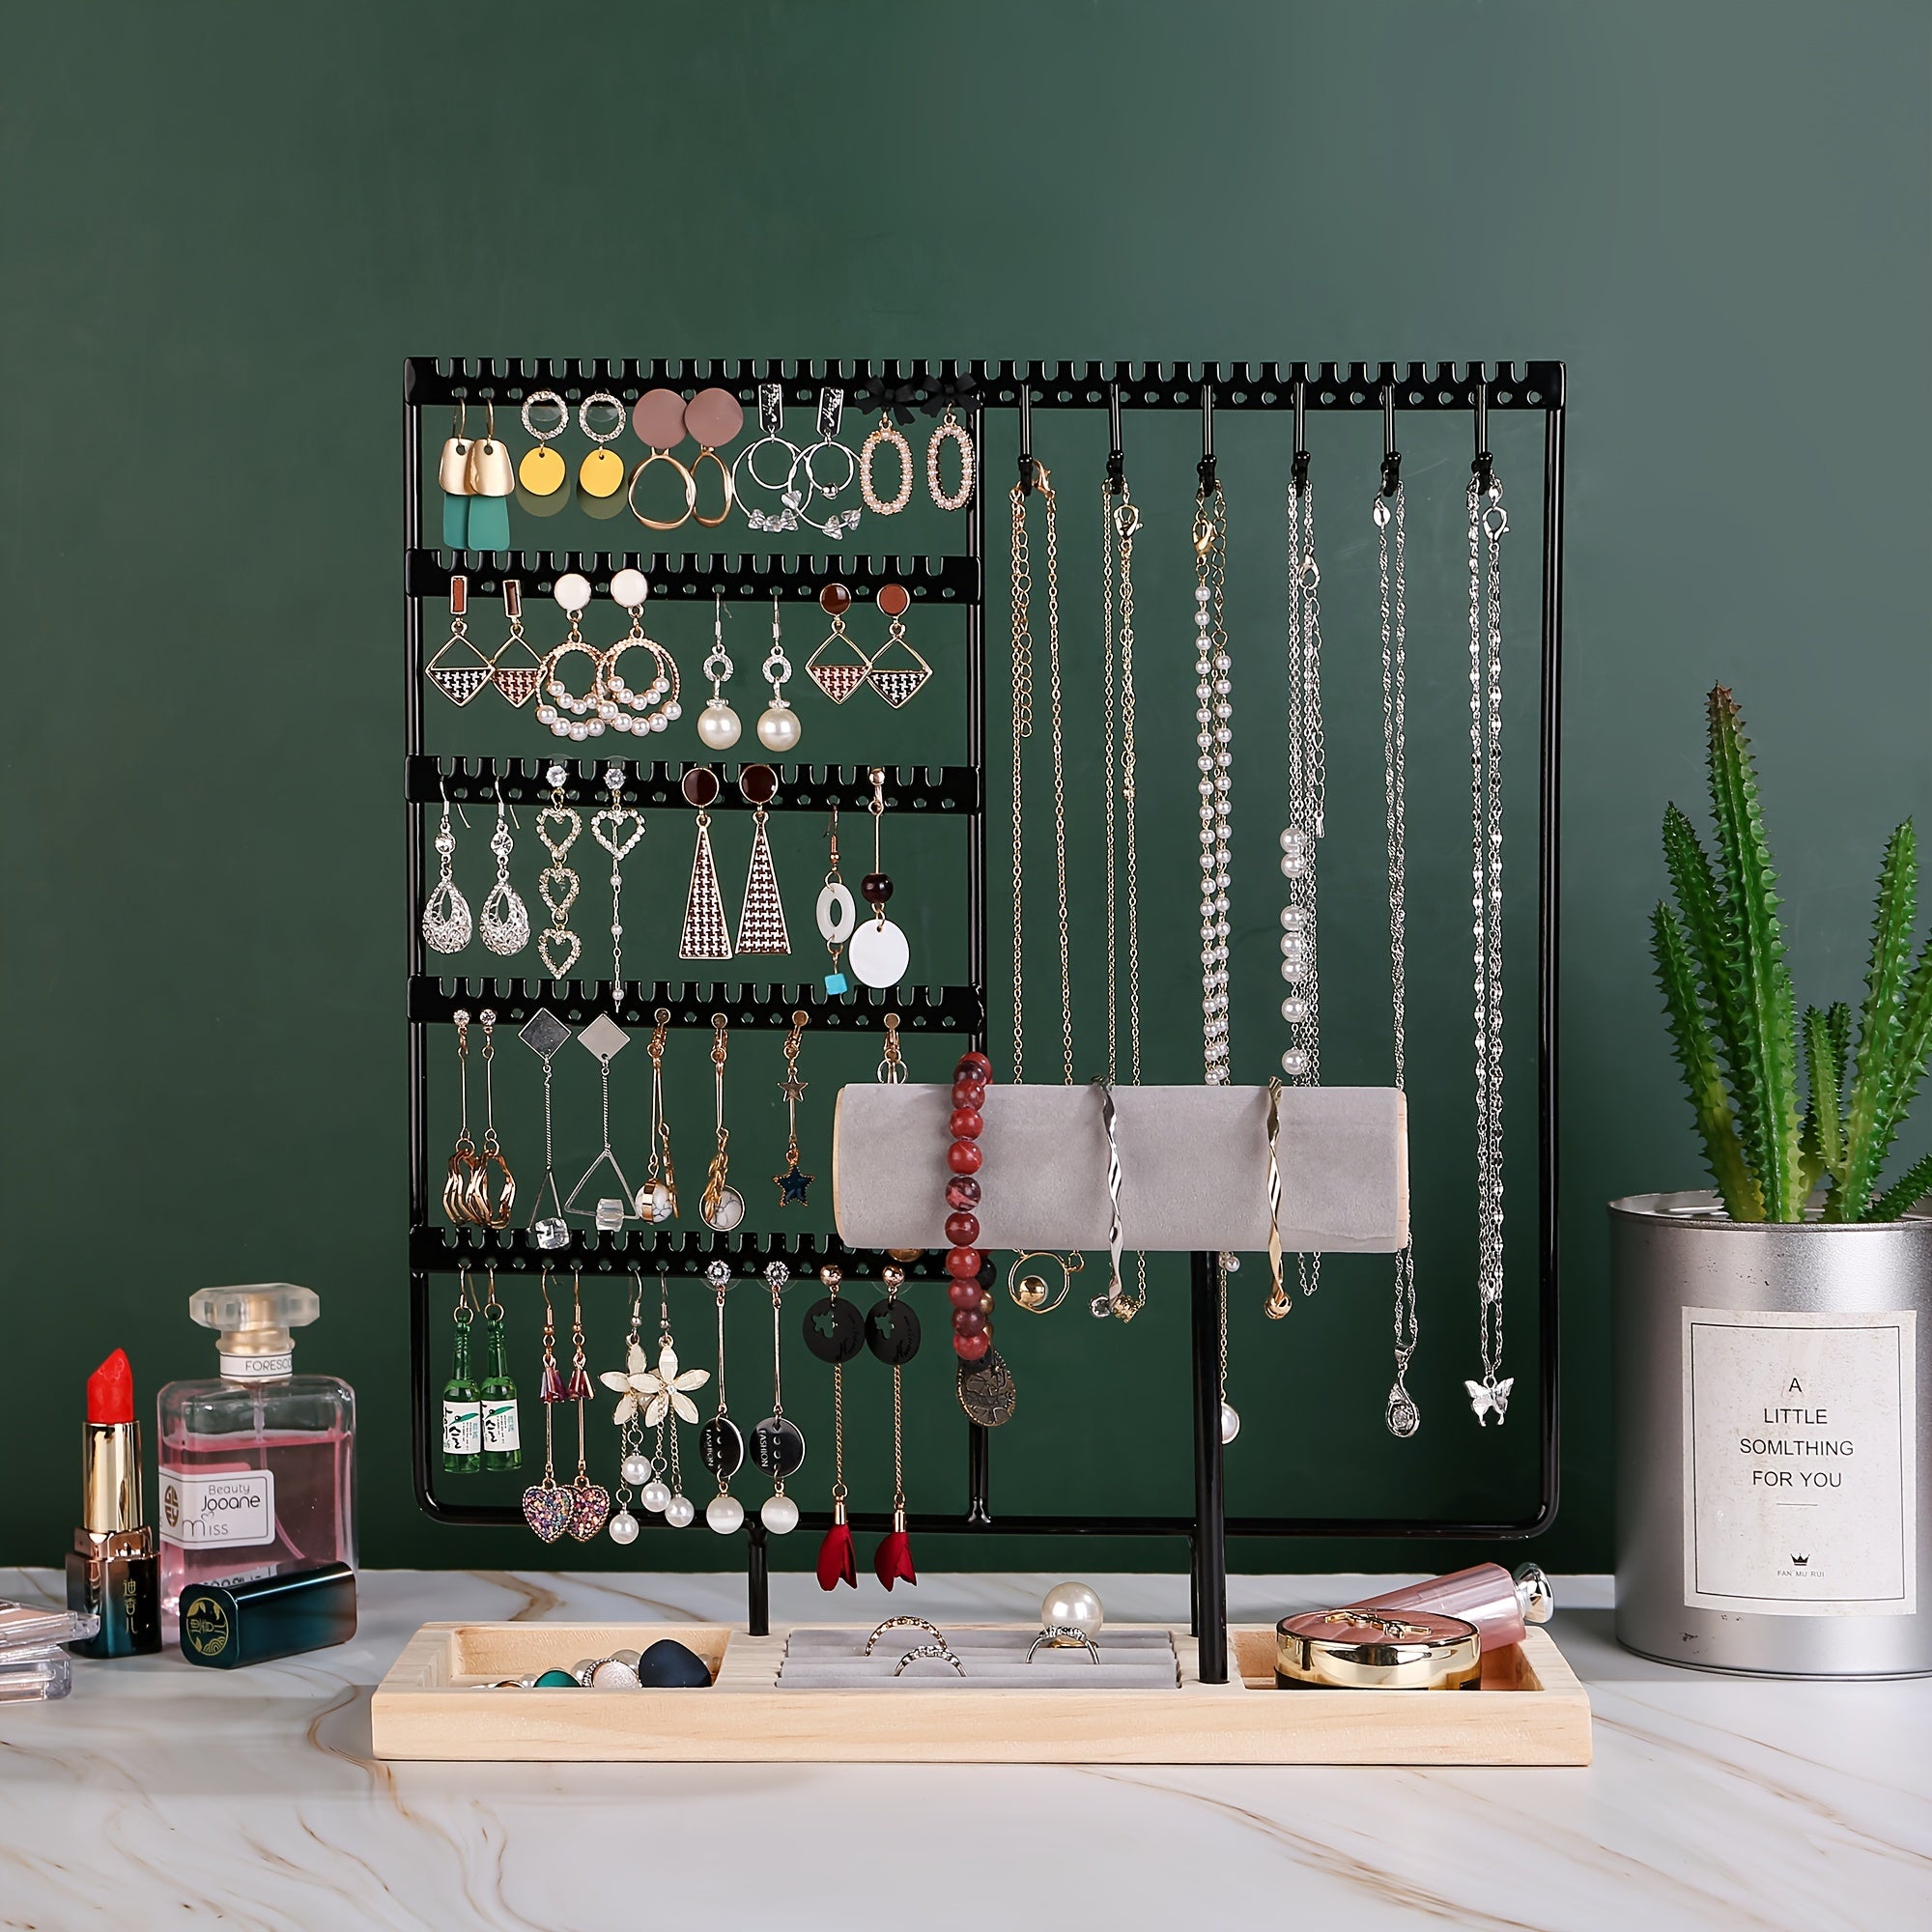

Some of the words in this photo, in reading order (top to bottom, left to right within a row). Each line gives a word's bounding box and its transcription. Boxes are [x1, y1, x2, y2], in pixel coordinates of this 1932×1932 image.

[1788, 1378, 1803, 1393] A
[1764, 1407, 1828, 1425] LITTLE
[757, 1429, 769, 1467] FASHION
[1740, 1437, 1854, 1456] SOMLTHING
[1752, 1470, 1793, 1487] FOR
[1800, 1471, 1842, 1488] YOU
[208, 1484, 250, 1495] Beauty
[201, 1494, 261, 1513] Jooane
